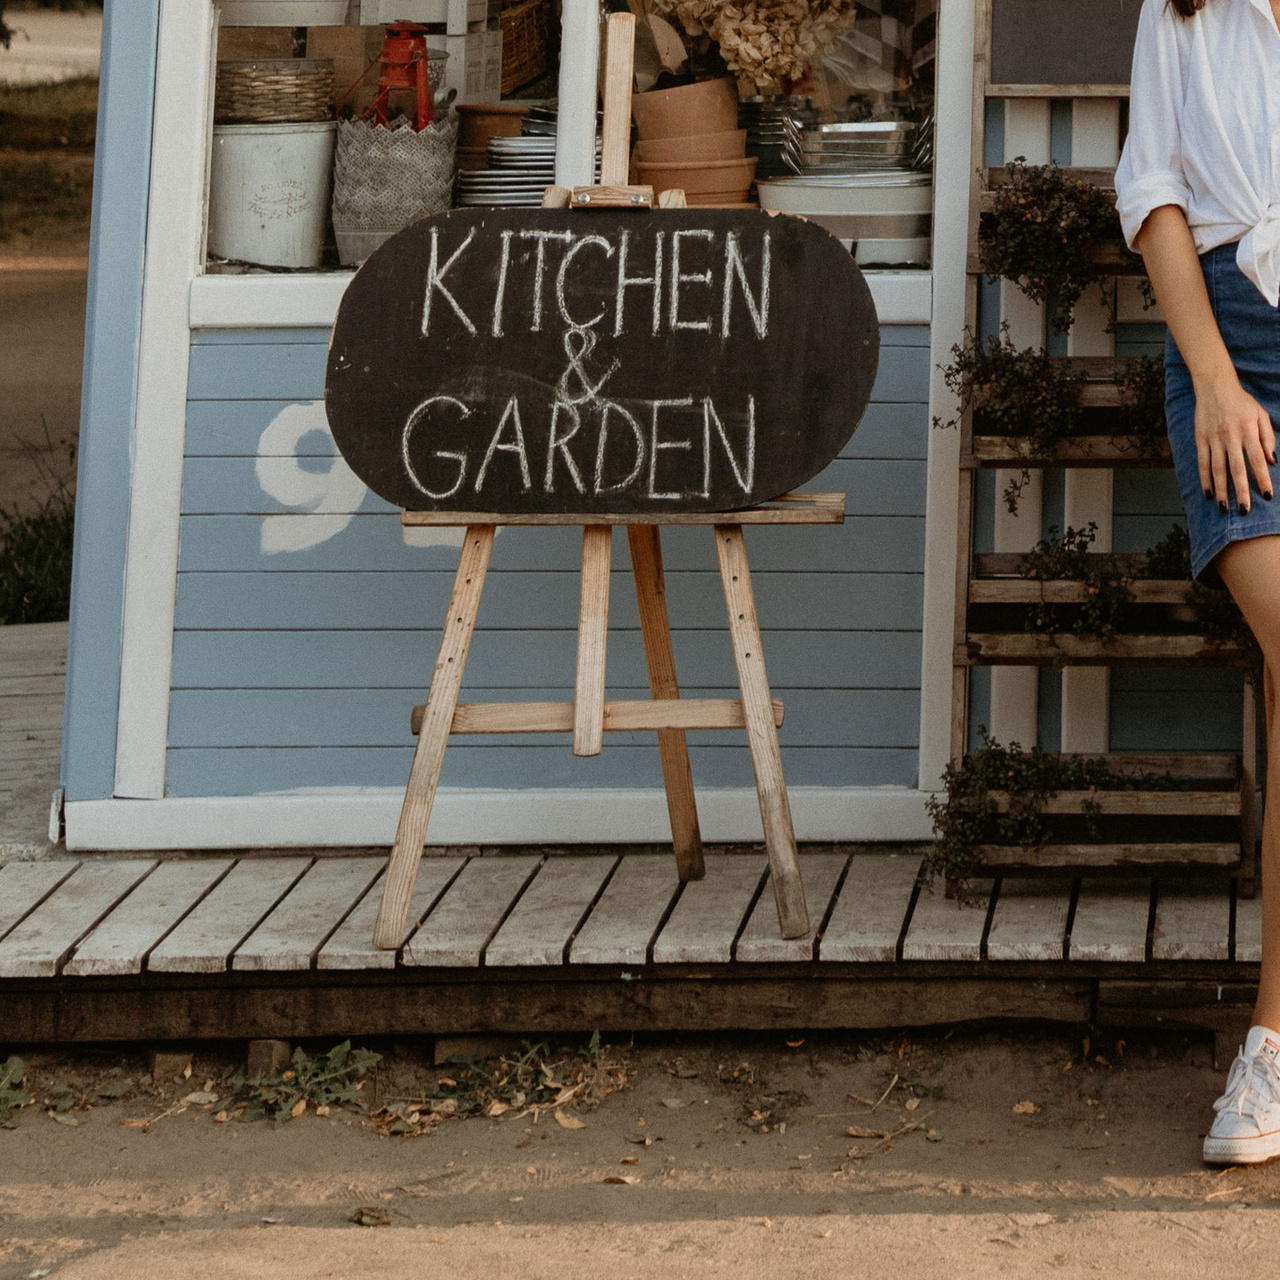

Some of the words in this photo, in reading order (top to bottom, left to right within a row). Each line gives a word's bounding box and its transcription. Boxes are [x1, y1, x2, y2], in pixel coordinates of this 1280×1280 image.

[421, 227, 770, 339] KITCHEN
[558, 326, 621, 407] &
[402, 394, 755, 500] GARDEN
